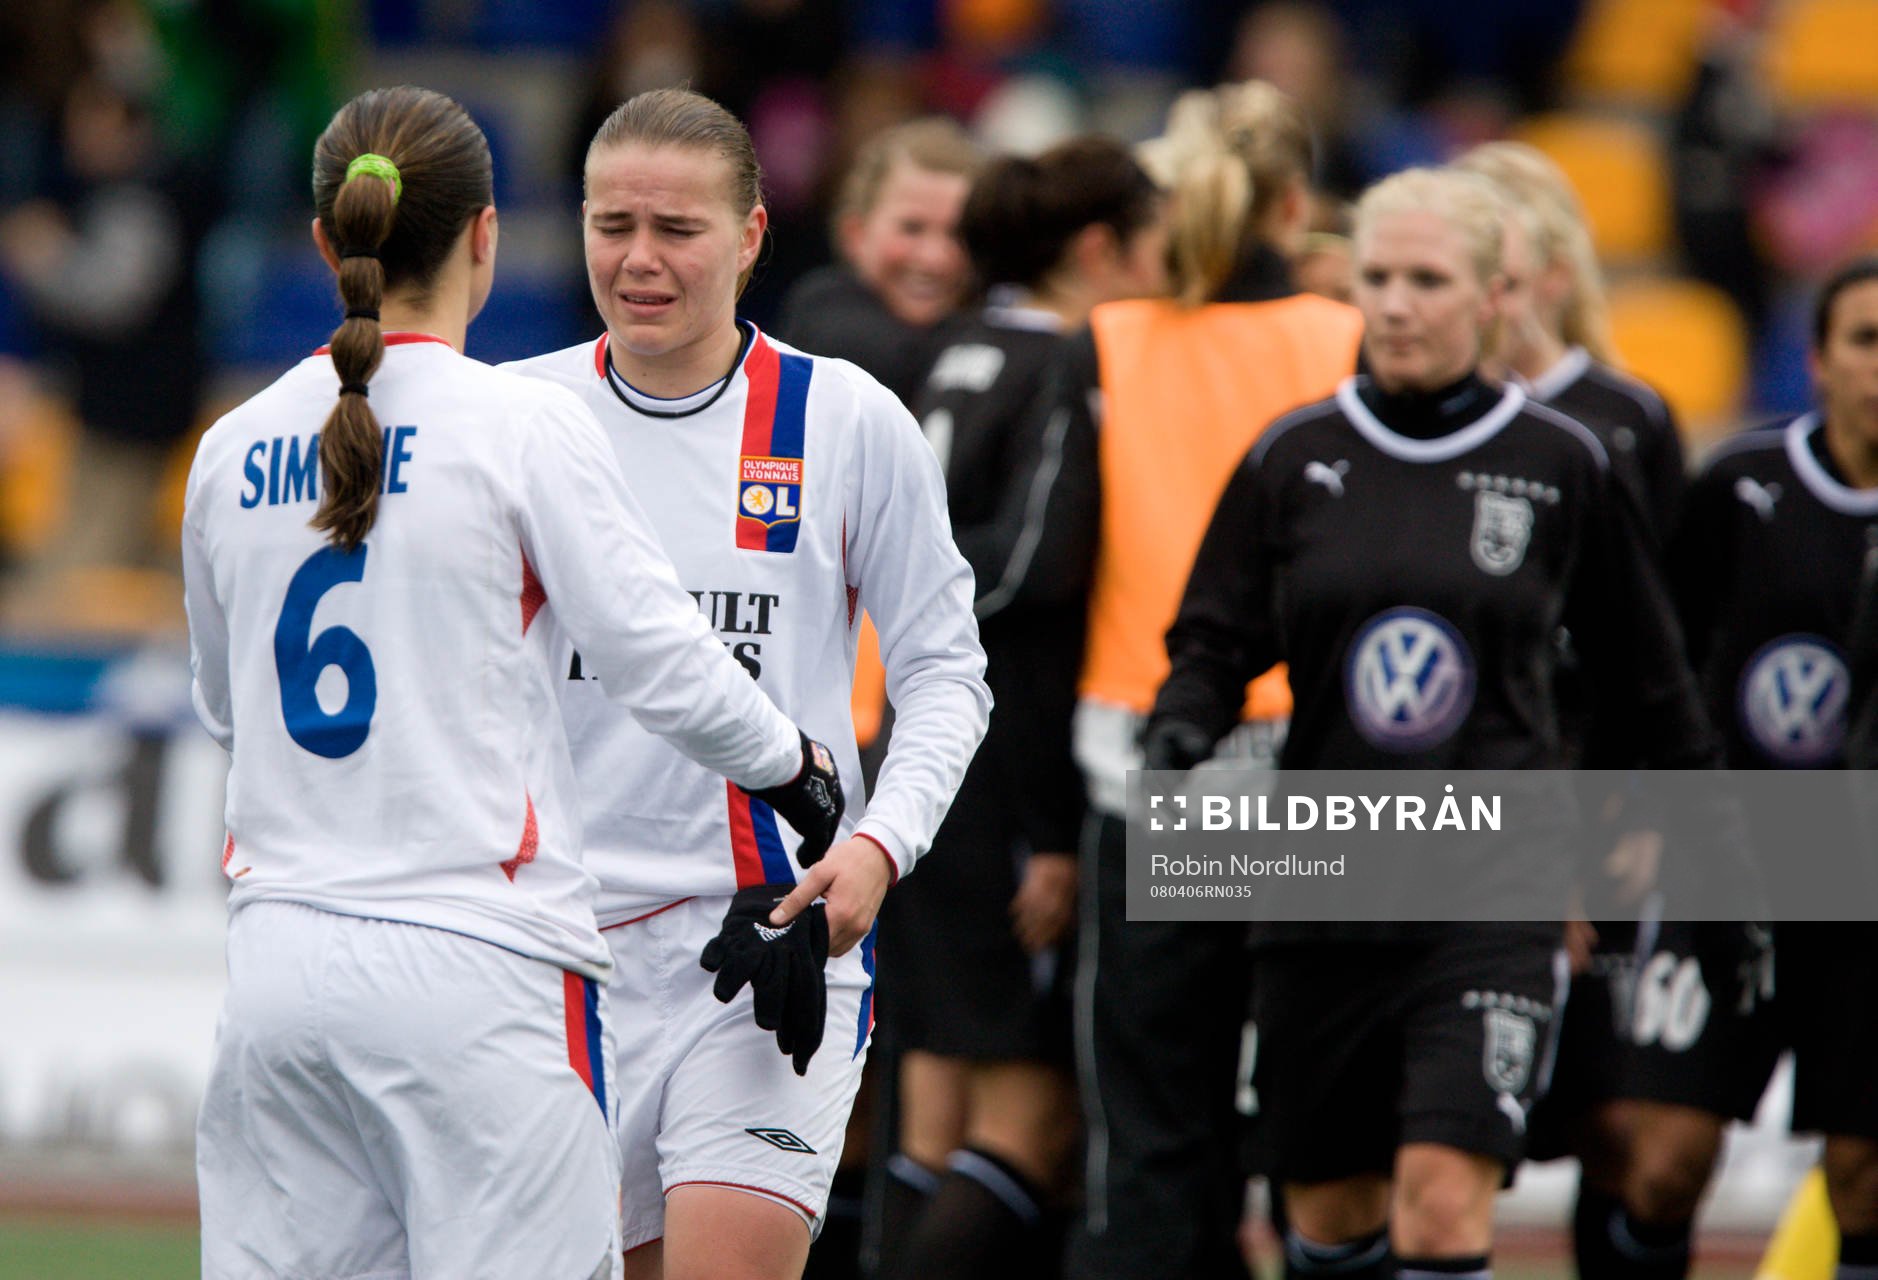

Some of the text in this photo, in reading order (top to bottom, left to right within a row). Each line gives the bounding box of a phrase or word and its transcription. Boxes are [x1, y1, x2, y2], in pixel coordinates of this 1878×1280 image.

[240, 426, 417, 509] SIME
[743, 460, 799, 472] OLYMPIQUE
[743, 469, 799, 481] LYONNAIS
[274, 541, 377, 759] 6
